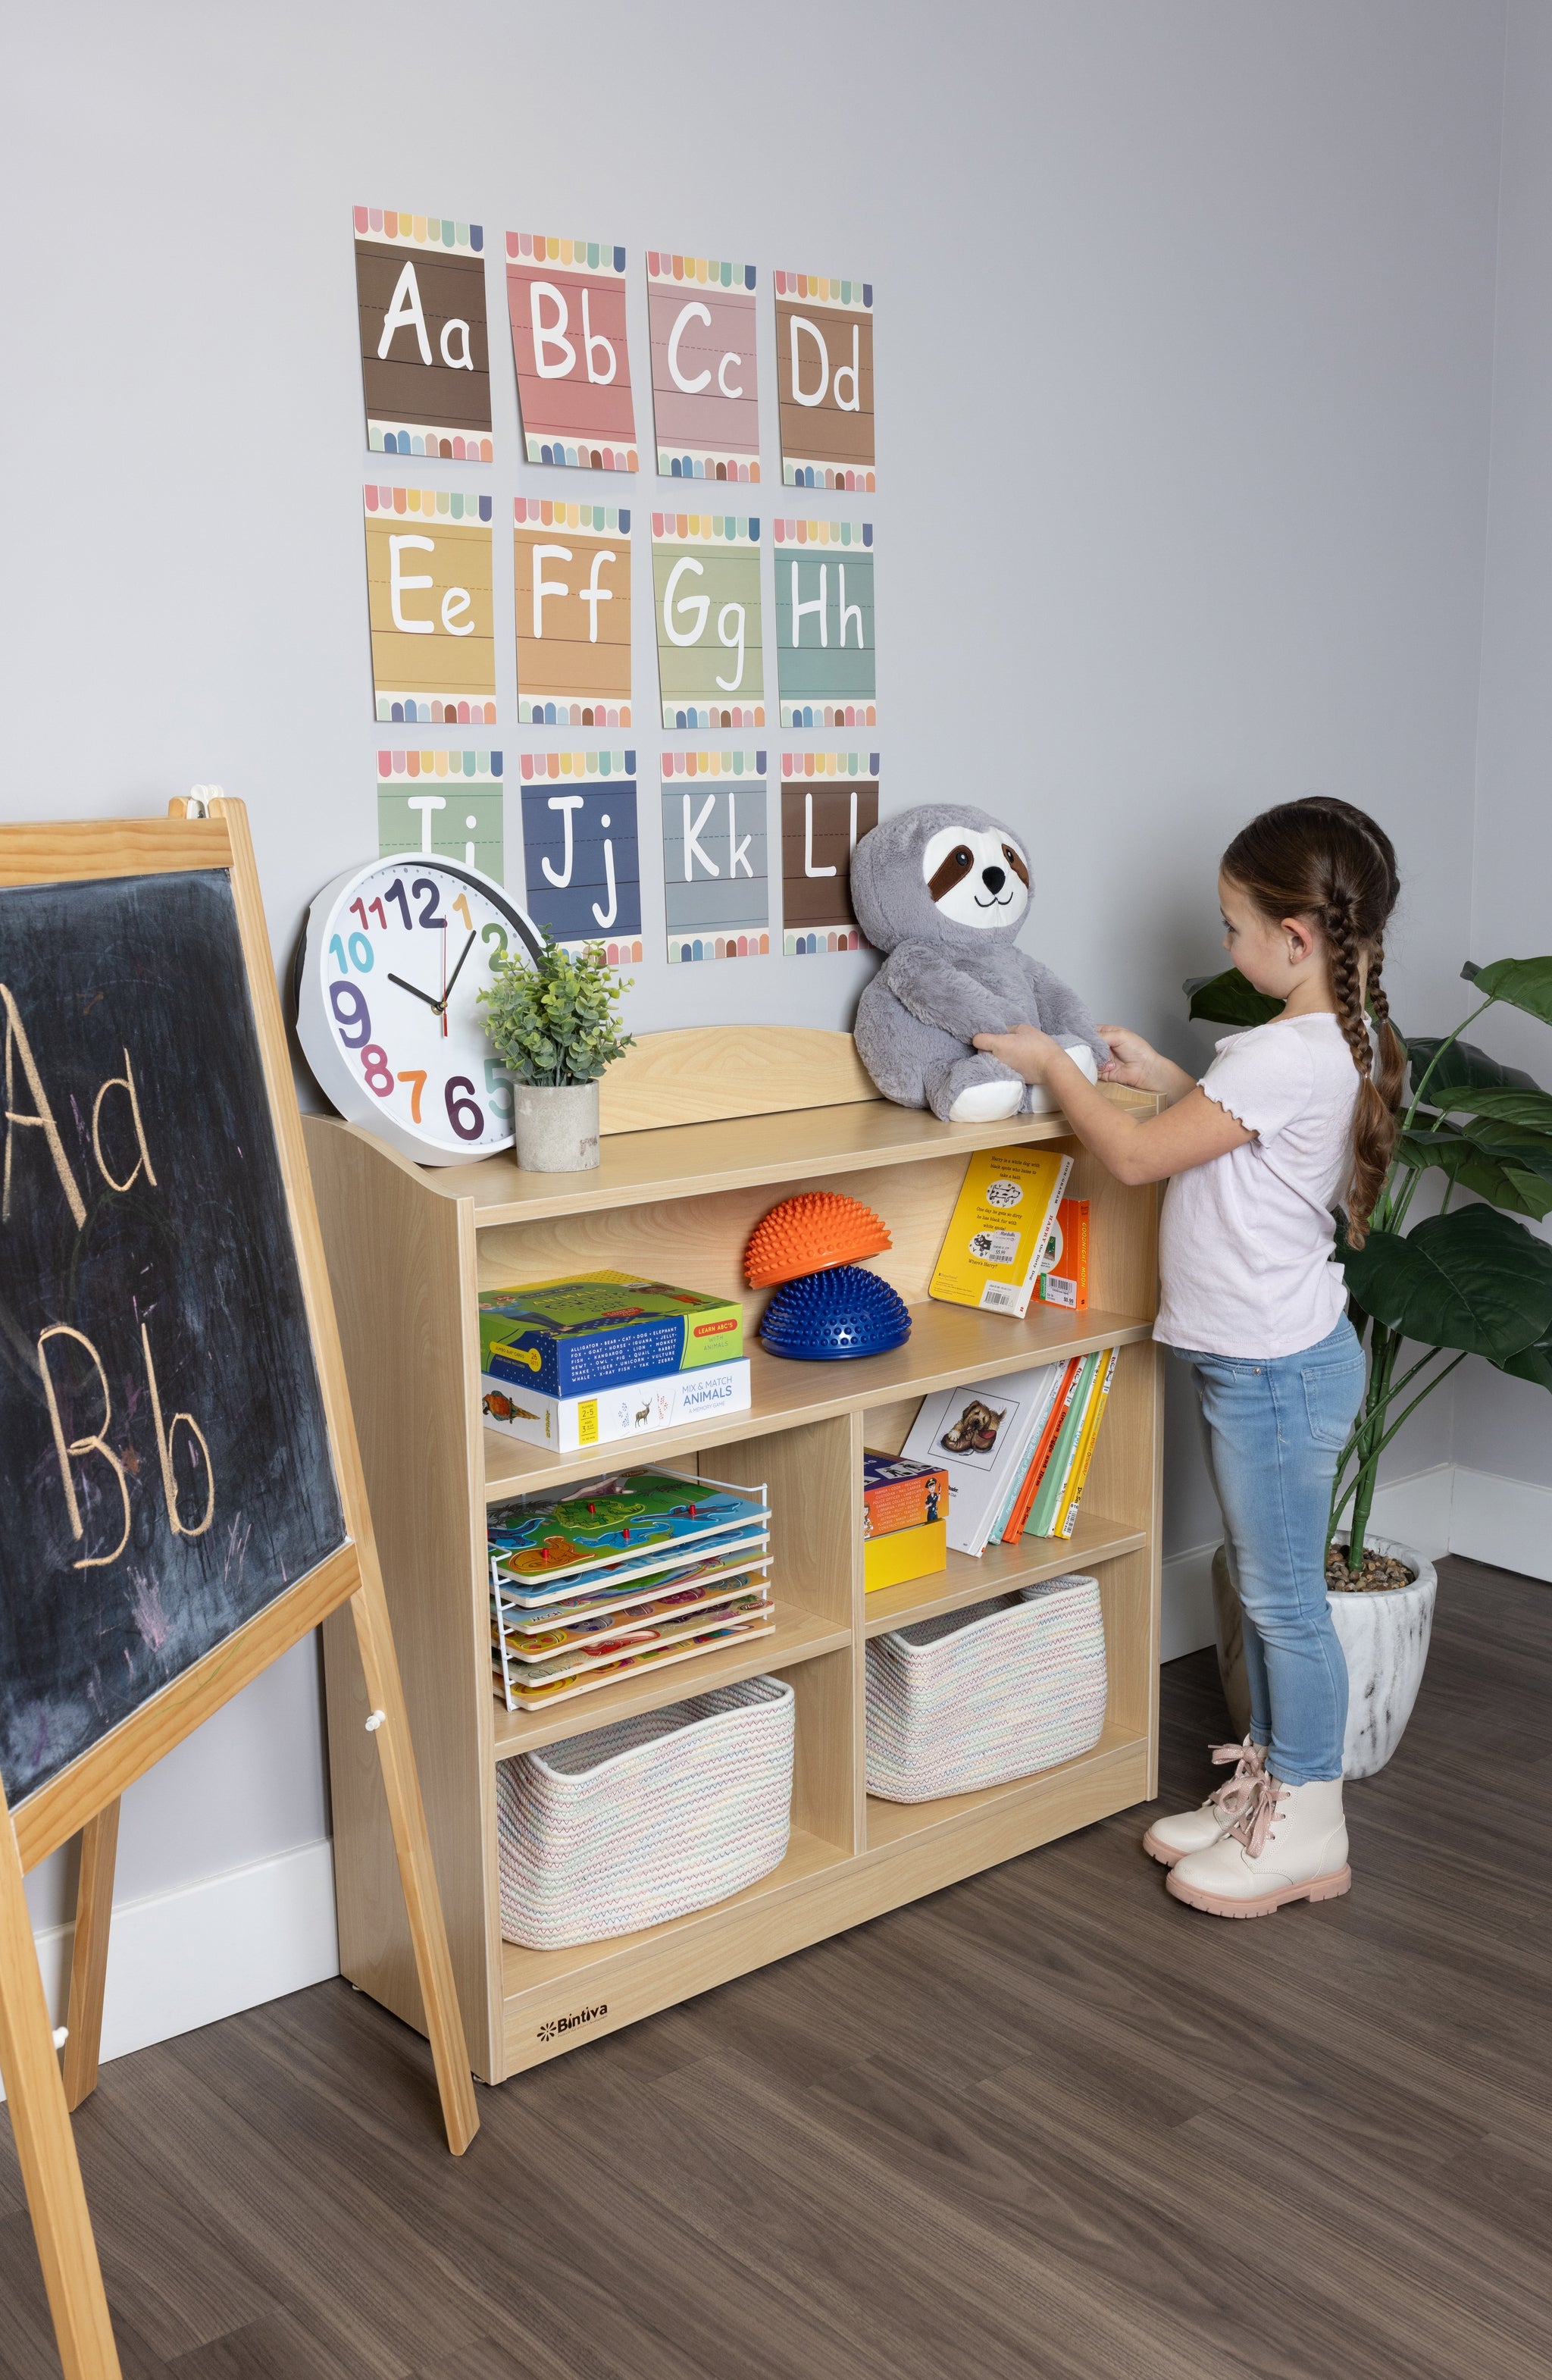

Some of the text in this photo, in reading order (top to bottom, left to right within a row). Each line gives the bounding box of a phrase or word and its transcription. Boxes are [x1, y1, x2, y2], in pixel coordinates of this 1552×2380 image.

[377, 261, 474, 371] Aa
[530, 281, 617, 385] Bb
[668, 302, 743, 399] Cc
[790, 315, 860, 412] Dd
[390, 534, 475, 637] Ee
[532, 543, 617, 644] Ff
[791, 561, 864, 649] Hh
[664, 557, 746, 691] Gg
[541, 796, 618, 929] Jj
[683, 792, 754, 883] Kk
[350, 896, 387, 931] 11
[384, 877, 447, 931] 12
[452, 893, 474, 931] 1
[330, 932, 374, 974] 10
[482, 923, 508, 972] 2
[329, 980, 371, 1049] 9
[359, 1044, 394, 1098] 8
[398, 1070, 427, 1123] 7
[444, 1076, 484, 1141] 6
[1042, 1215, 1053, 1243] HARRY
[571, 1342, 599, 1352] ALLIGATOR
[653, 1326, 677, 1336] ELEPHANT
[594, 1350, 623, 1359] KANGAROO
[699, 1326, 715, 1334] LEARN
[620, 1358, 644, 1366] UNICORN
[652, 1351, 675, 1359] VULTURE
[683, 1384, 696, 1394] MIX
[706, 1376, 732, 1388] MATCH
[684, 1386, 732, 1406] ANIMALS
[1056, 1412, 1066, 1432] Green
[37, 1322, 214, 1569] Bb
[1049, 1436, 1058, 1452] Eggs
[1036, 1472, 1044, 1486] Ham
[558, 2005, 608, 2033] Bintiva
